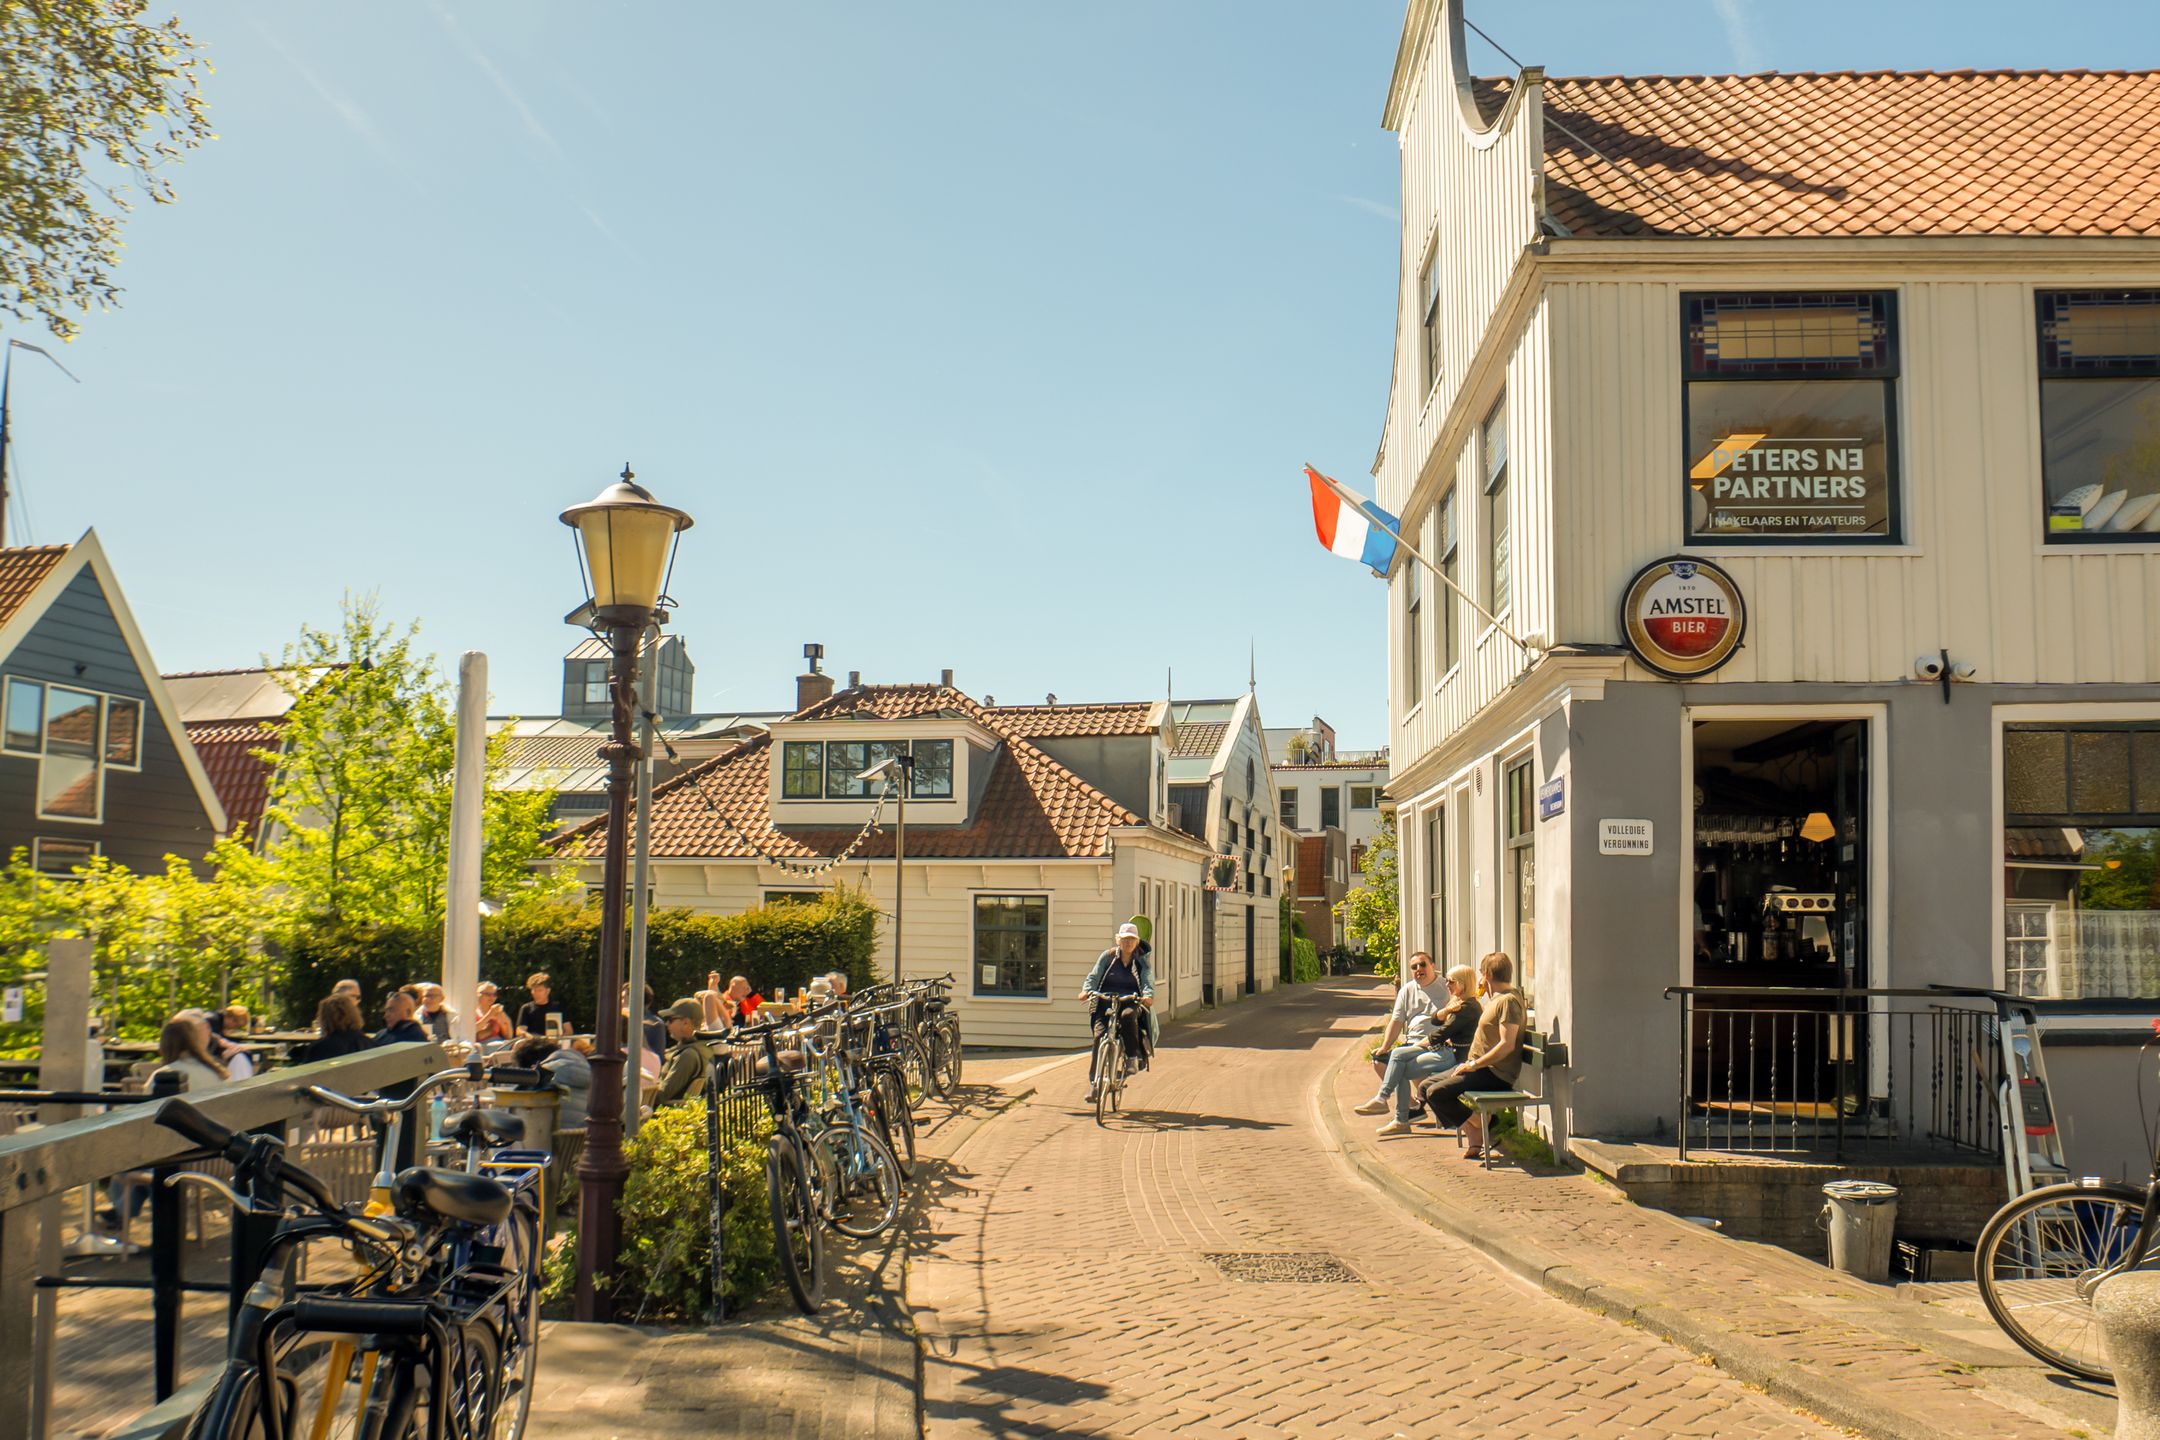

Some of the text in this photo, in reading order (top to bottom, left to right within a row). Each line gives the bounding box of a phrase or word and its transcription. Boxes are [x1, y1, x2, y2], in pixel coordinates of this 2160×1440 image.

[1713, 448, 1818, 471] PETERS
[1714, 476, 1866, 499] PARTNERS
[1715, 515, 1866, 526] MAKELAARS EN TAXATEURS
[1650, 598, 1725, 615] AMSTEL
[1672, 621, 1705, 633] BIER
[1607, 825, 1646, 835] VOLLEDIGE
[1603, 839, 1649, 849] VERGUNNING
